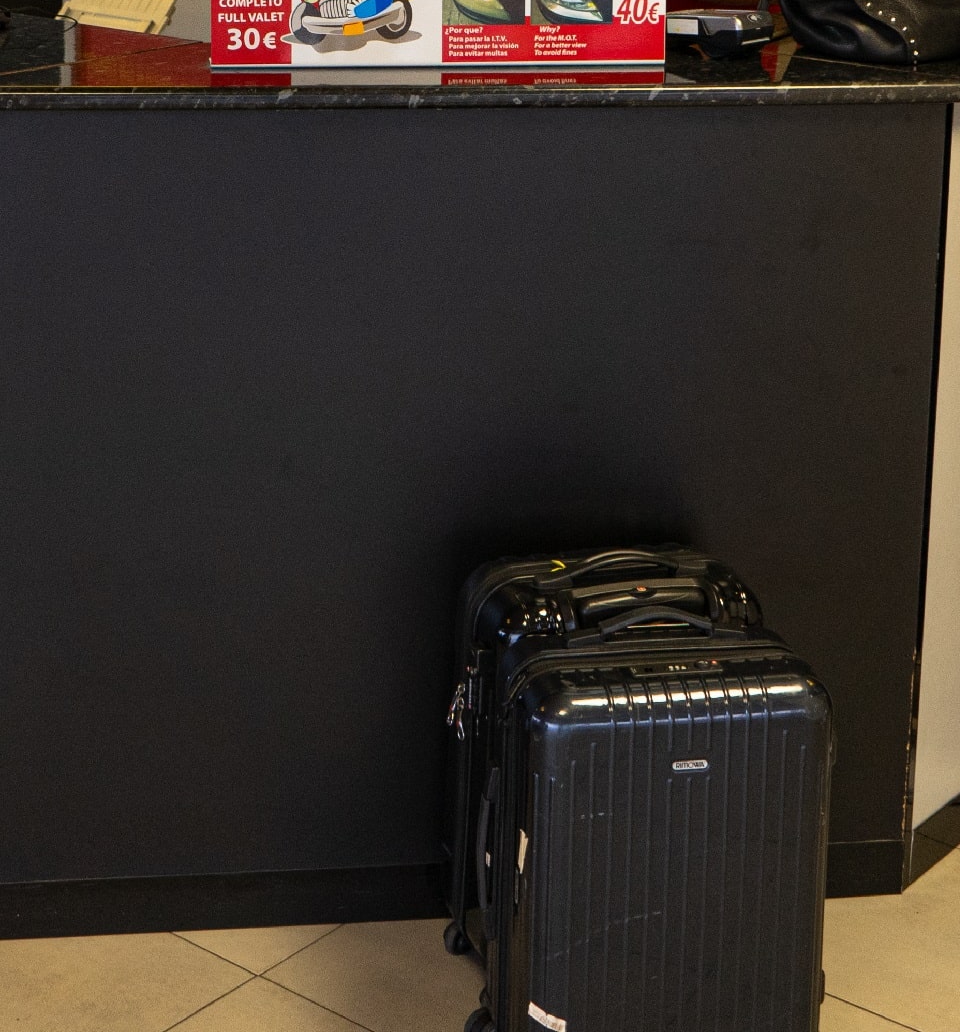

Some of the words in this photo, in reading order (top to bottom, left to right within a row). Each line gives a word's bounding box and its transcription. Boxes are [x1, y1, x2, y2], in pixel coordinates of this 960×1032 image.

[218, 12, 246, 23] FULL
[247, 11, 285, 22] VALET
[445, 26, 463, 35] ¿Por
[464, 26, 483, 35] que?
[539, 25, 561, 34] Why?
[227, 28, 277, 50] 30€
[465, 36, 483, 44] pasar
[465, 43, 490, 51] mejorar
